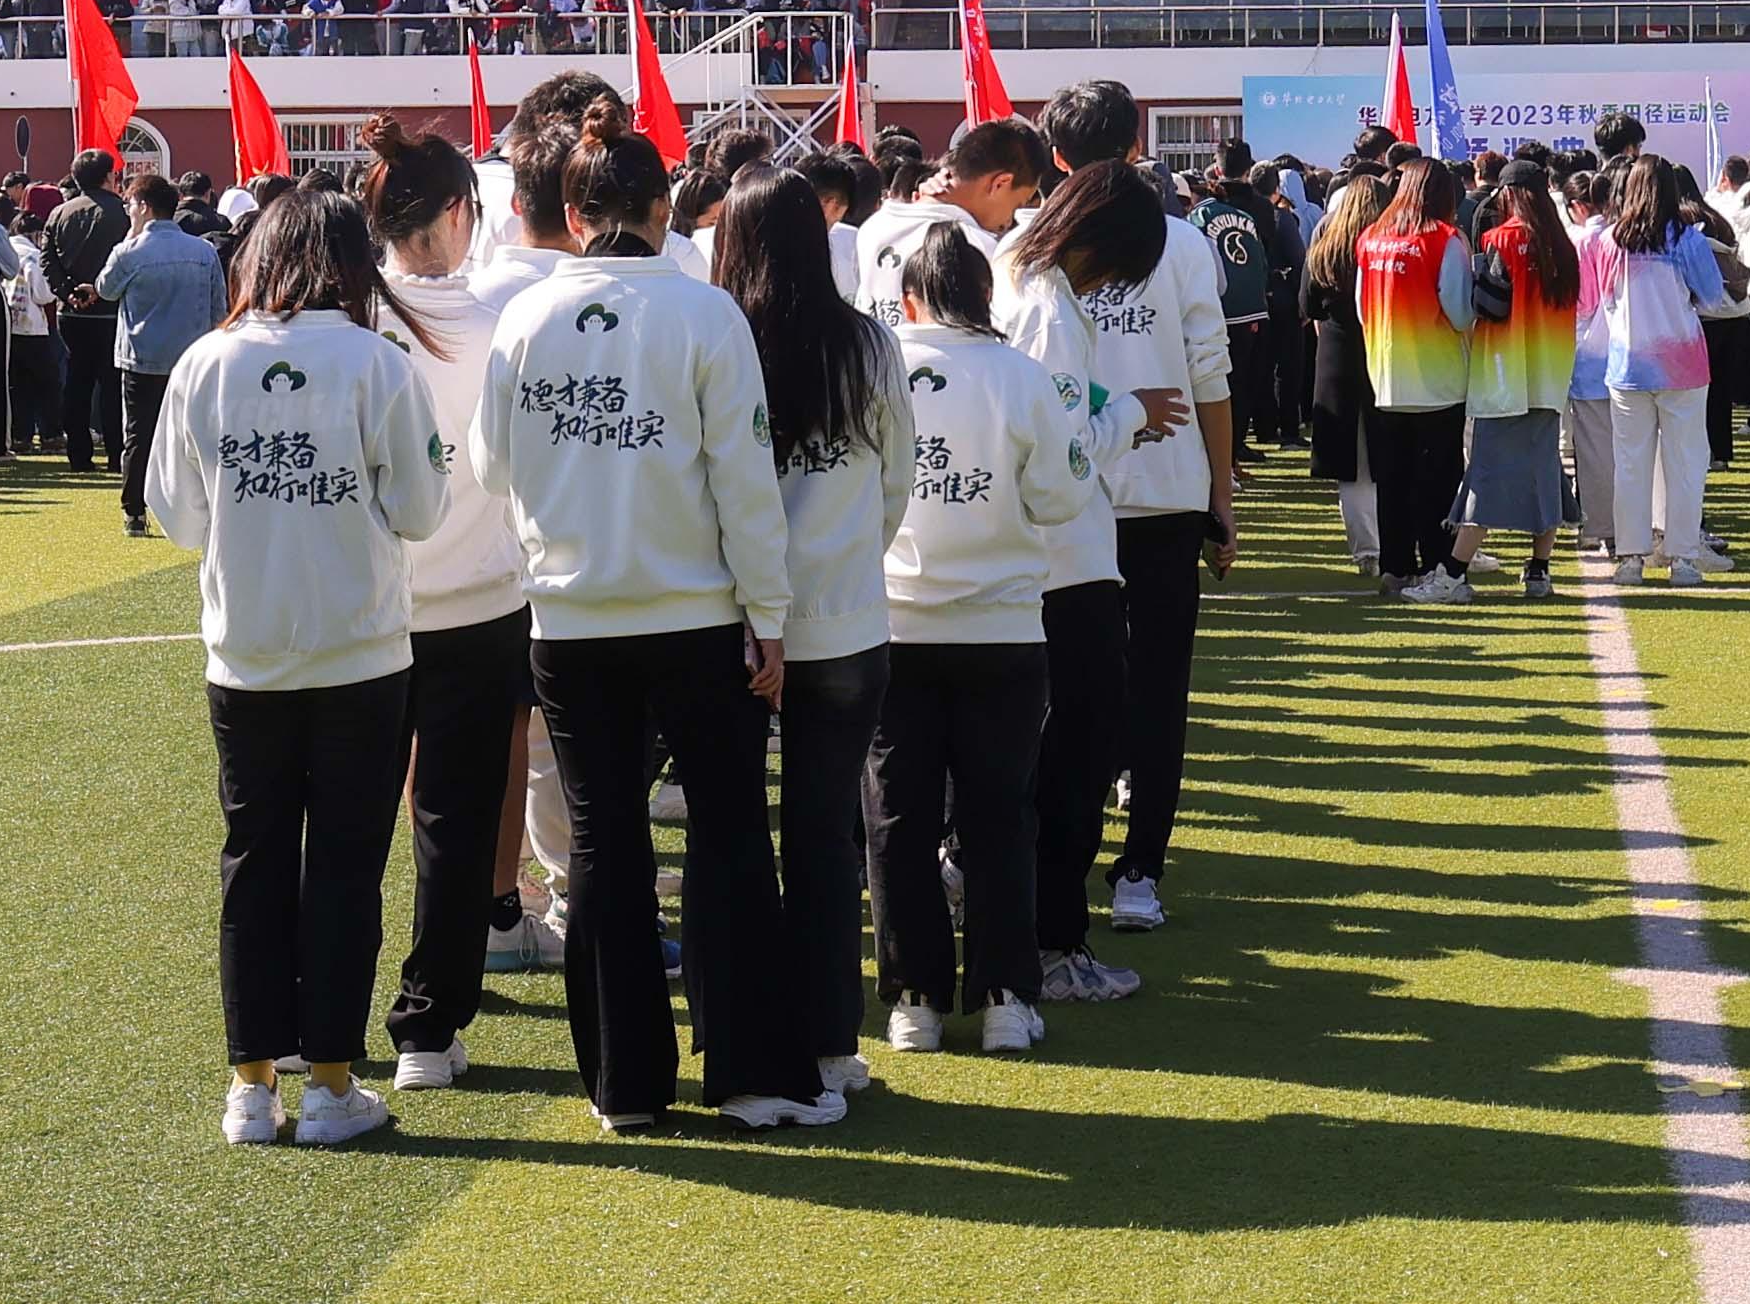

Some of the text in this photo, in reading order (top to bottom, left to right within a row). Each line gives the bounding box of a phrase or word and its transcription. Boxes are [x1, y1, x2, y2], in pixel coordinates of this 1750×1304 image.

[520, 372, 629, 417] 德才兼备
[550, 409, 666, 452] 知行唯实
[233, 466, 360, 508] 知行唯实
